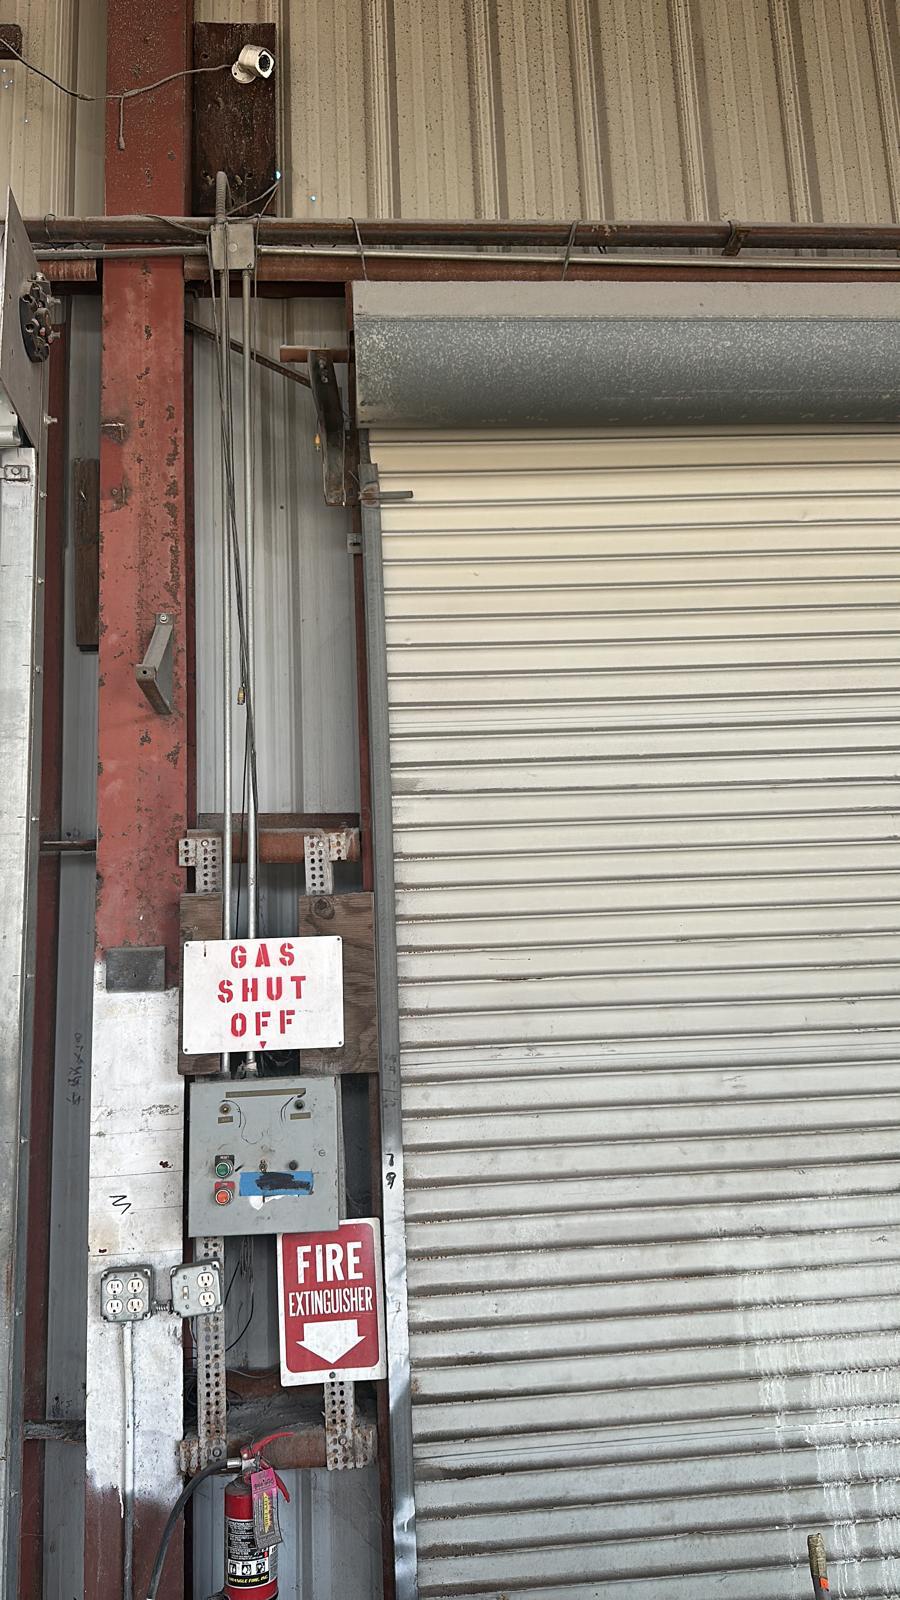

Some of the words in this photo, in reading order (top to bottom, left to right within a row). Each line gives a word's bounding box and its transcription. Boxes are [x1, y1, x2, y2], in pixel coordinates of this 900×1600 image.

[231, 943, 295, 968] GAS
[218, 976, 306, 1003] SHUT
[231, 1010, 295, 1037] OFF
[297, 1241, 363, 1284] FIRE
[289, 1287, 373, 1317] EXTINGUISHER
